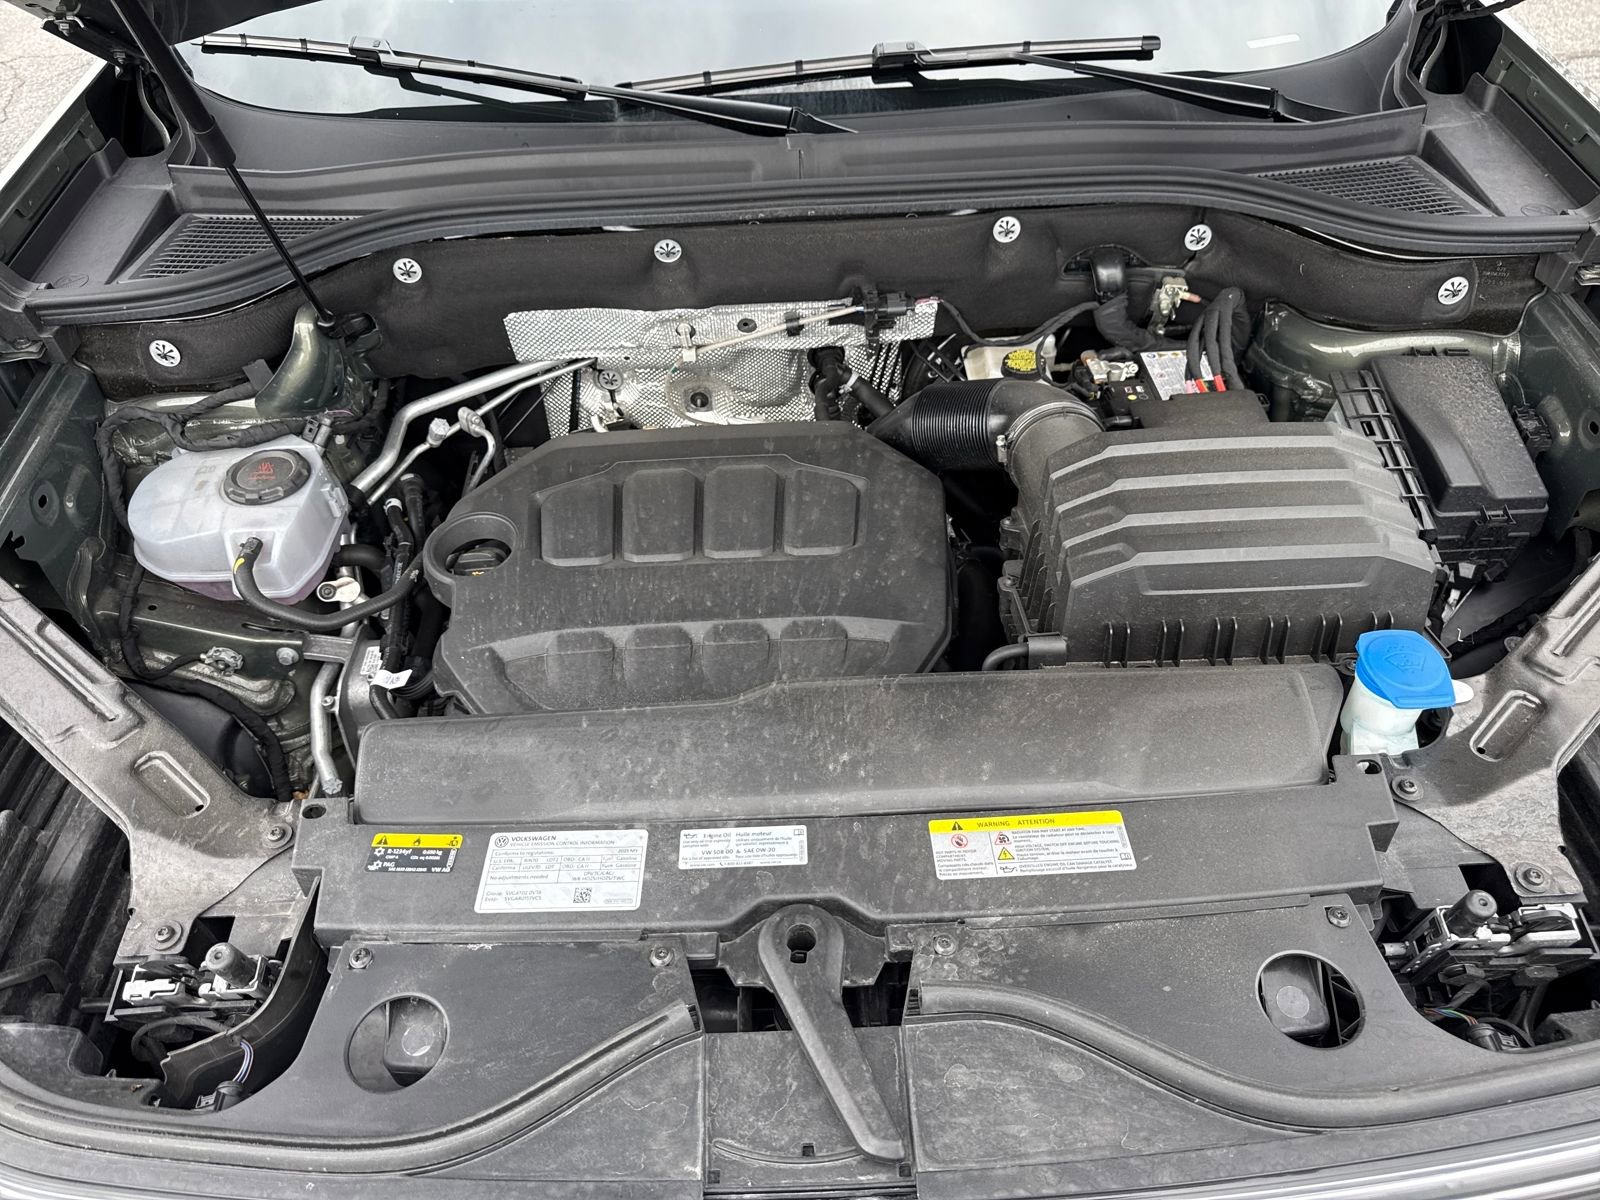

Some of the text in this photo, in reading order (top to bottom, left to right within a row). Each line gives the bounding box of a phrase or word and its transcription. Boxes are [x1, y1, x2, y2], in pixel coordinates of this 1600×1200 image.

[976, 818, 1056, 828] WARNING ATTENTION
[386, 847, 413, 857] R-1234yf
